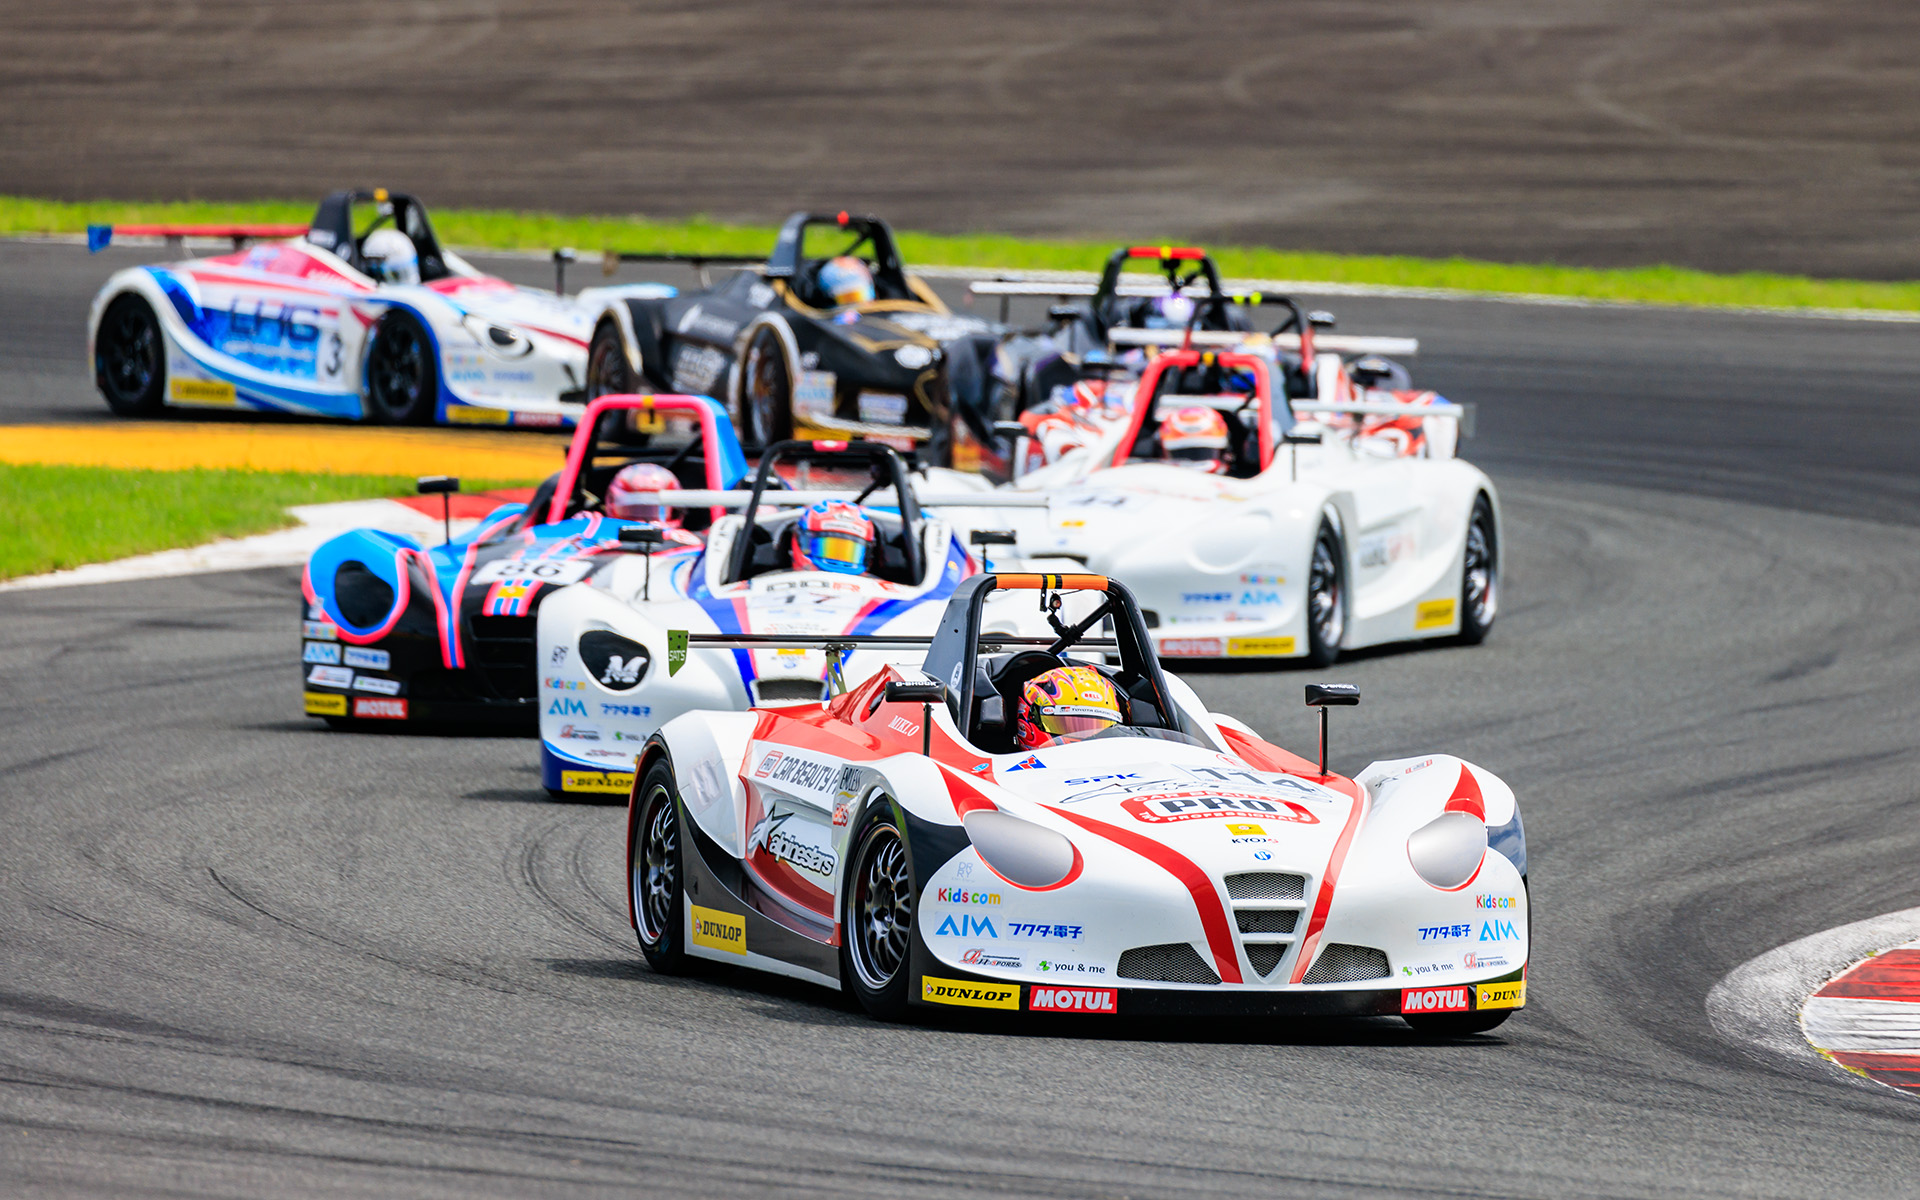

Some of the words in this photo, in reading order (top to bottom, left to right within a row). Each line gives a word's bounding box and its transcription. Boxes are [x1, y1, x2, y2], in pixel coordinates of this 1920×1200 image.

[669, 650, 686, 661] SATS
[1084, 692, 1100, 700] BELL
[548, 698, 588, 717] AIM
[1064, 772, 1144, 786] SPK
[1159, 797, 1278, 814] PRO
[938, 887, 968, 903] Kids
[971, 892, 1001, 905] com
[1476, 894, 1497, 909] Kids
[1498, 896, 1516, 908] com
[703, 920, 742, 942] DUNLOP
[935, 914, 999, 938] AIM
[1008, 922, 1083, 939] フクダ電子
[1418, 924, 1471, 940] フクダ電子
[1479, 919, 1520, 941] AIM
[1054, 963, 1074, 972] you
[1088, 965, 1106, 974] me
[1414, 966, 1431, 975] you
[1440, 963, 1454, 971] me
[935, 986, 1012, 1001] DUNLOP
[1033, 989, 1113, 1010] MOTUL
[1405, 989, 1467, 1010] MOTUL
